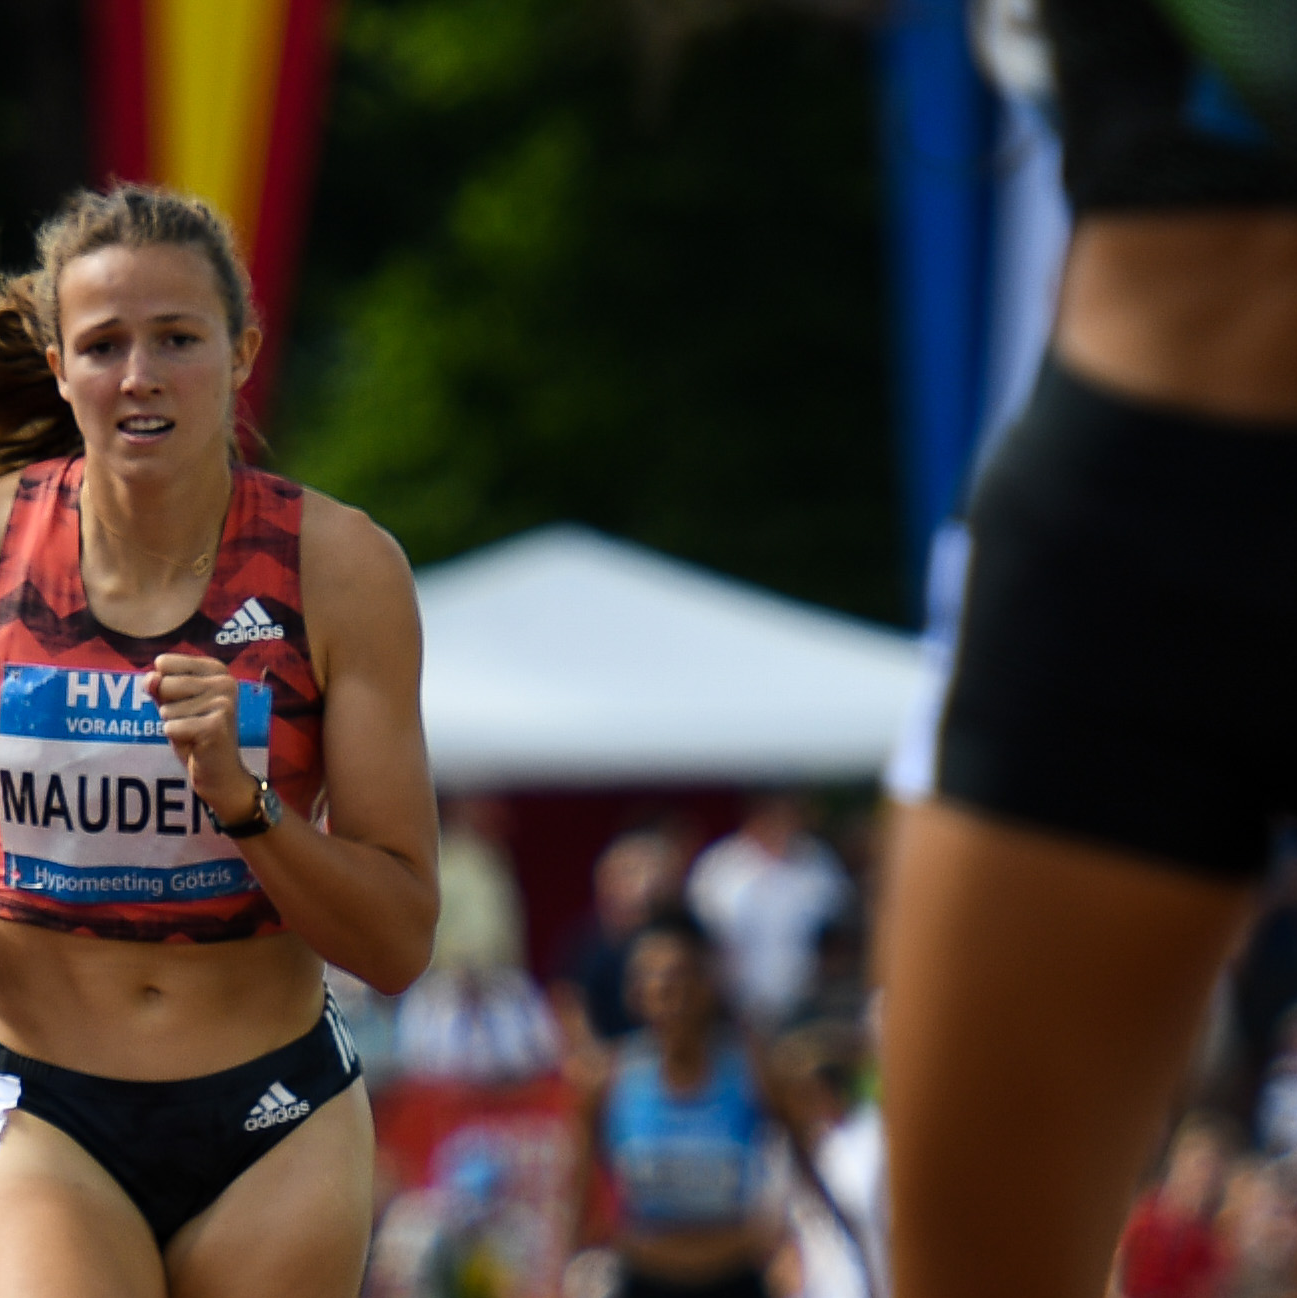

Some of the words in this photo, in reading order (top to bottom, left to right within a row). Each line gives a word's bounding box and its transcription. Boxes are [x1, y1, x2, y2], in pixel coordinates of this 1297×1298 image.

[215, 622, 284, 646] adidas
[35, 866, 163, 896] Hypomeeting
[171, 868, 232, 891] Götzis
[244, 1100, 310, 1133] adidas
